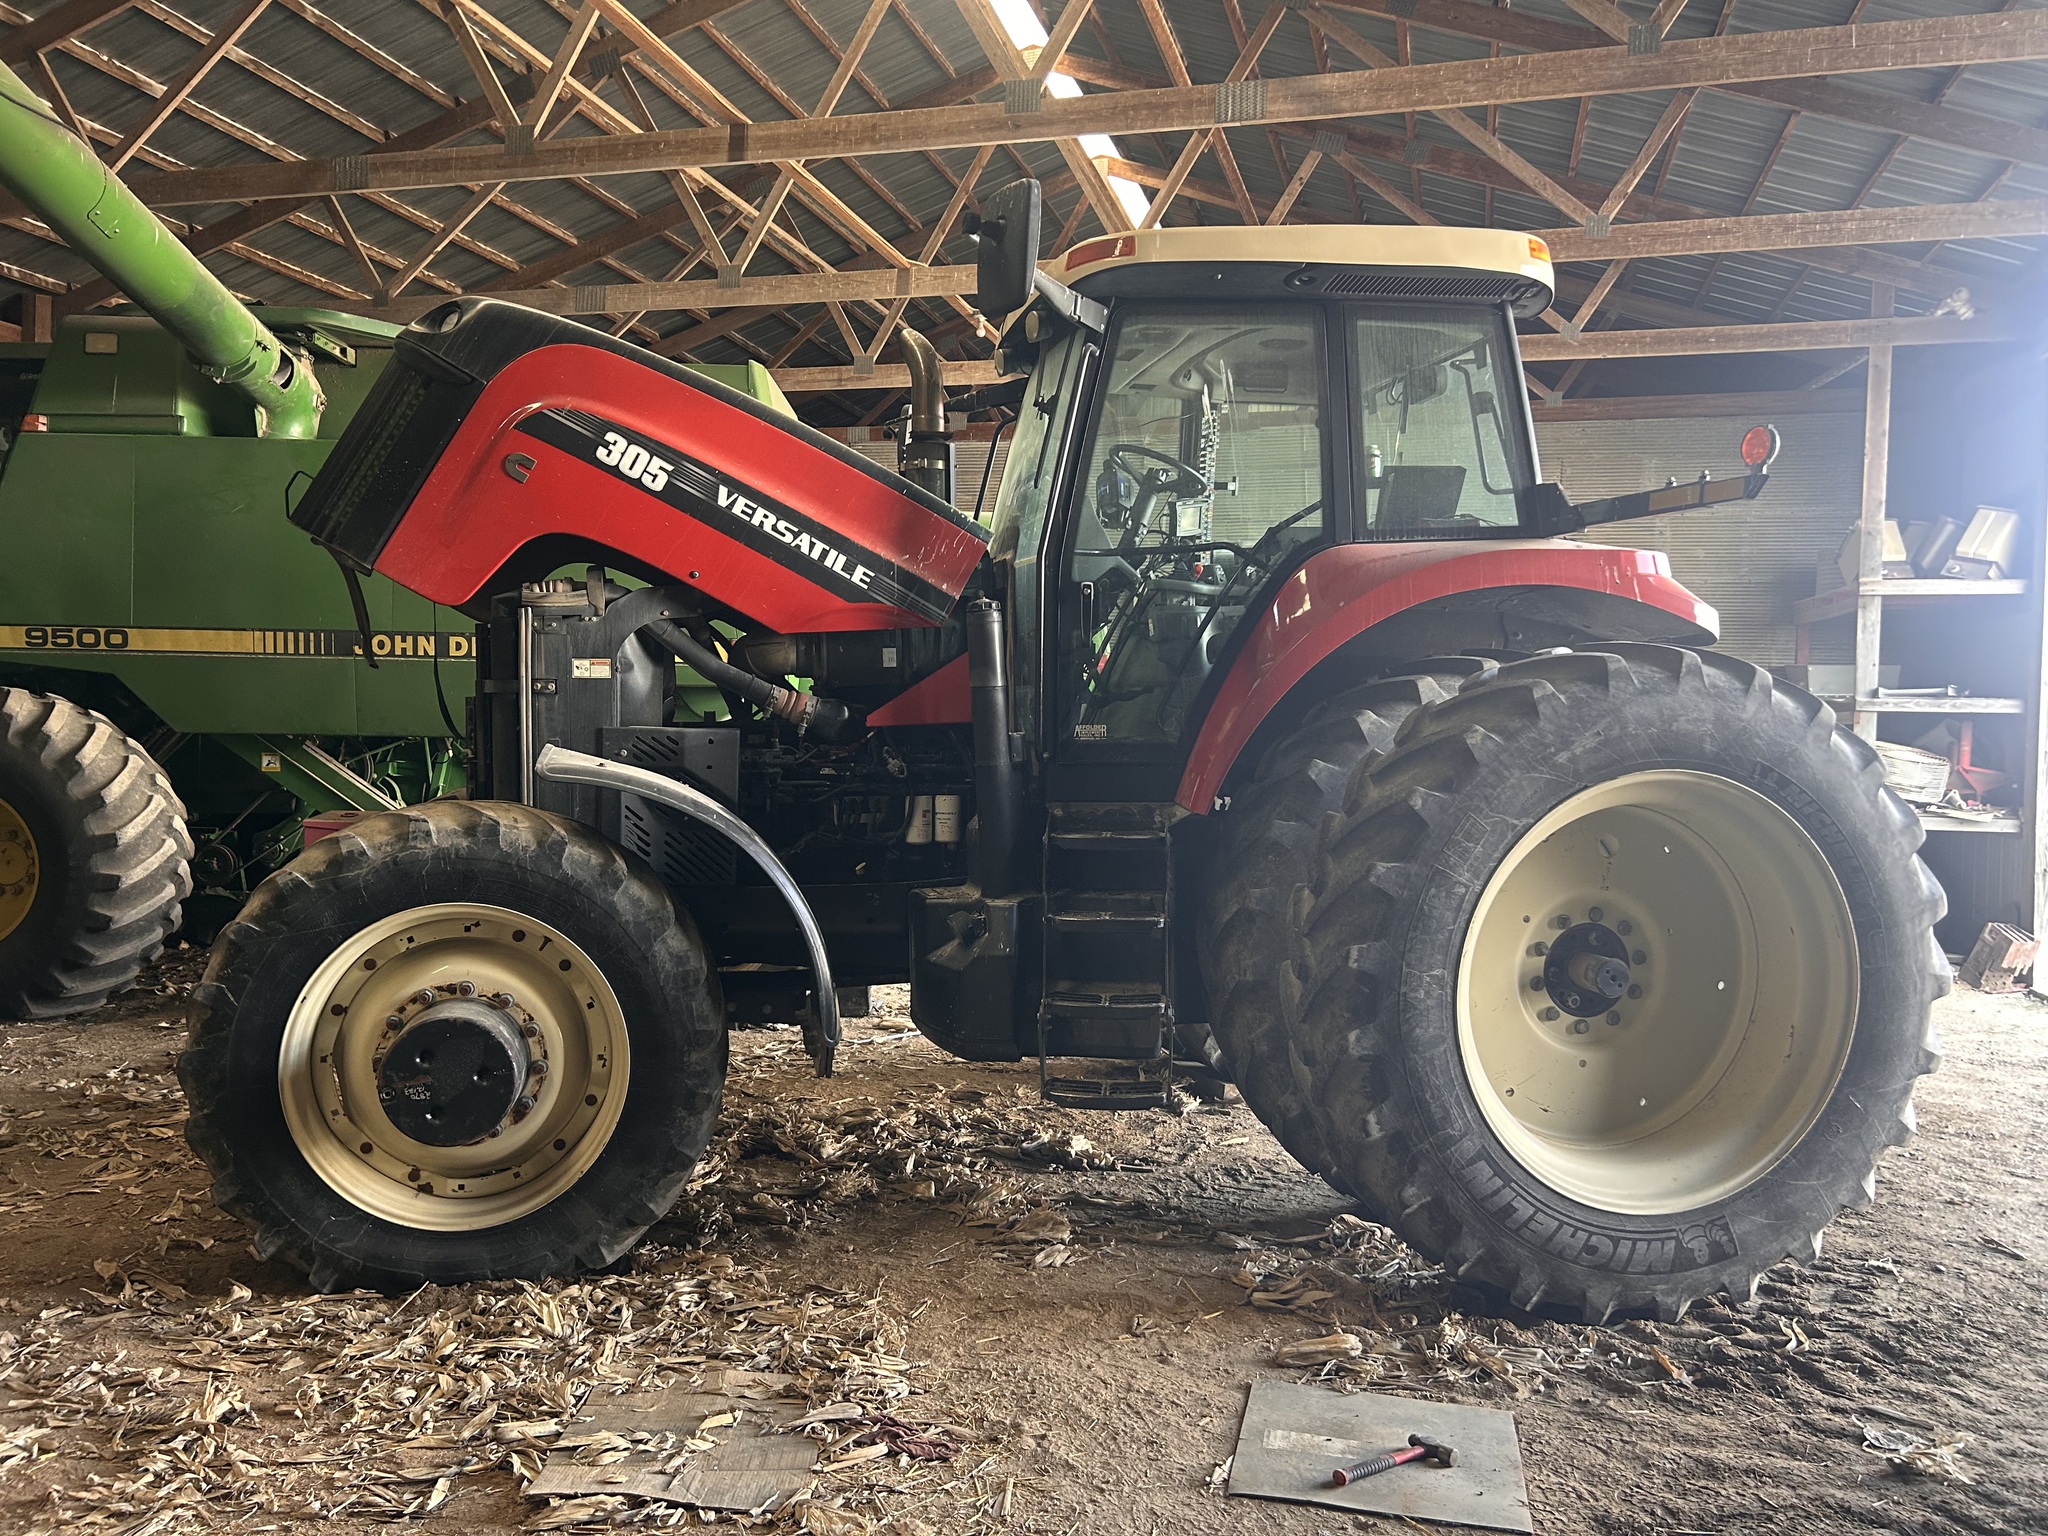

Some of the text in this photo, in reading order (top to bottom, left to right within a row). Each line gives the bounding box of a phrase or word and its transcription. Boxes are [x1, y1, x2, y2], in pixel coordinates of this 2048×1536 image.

[596, 432, 675, 492] 305
[717, 484, 876, 590] VERSATILE
[25, 627, 129, 649] 9500
[1460, 1159, 1676, 1272] MICHELIN
